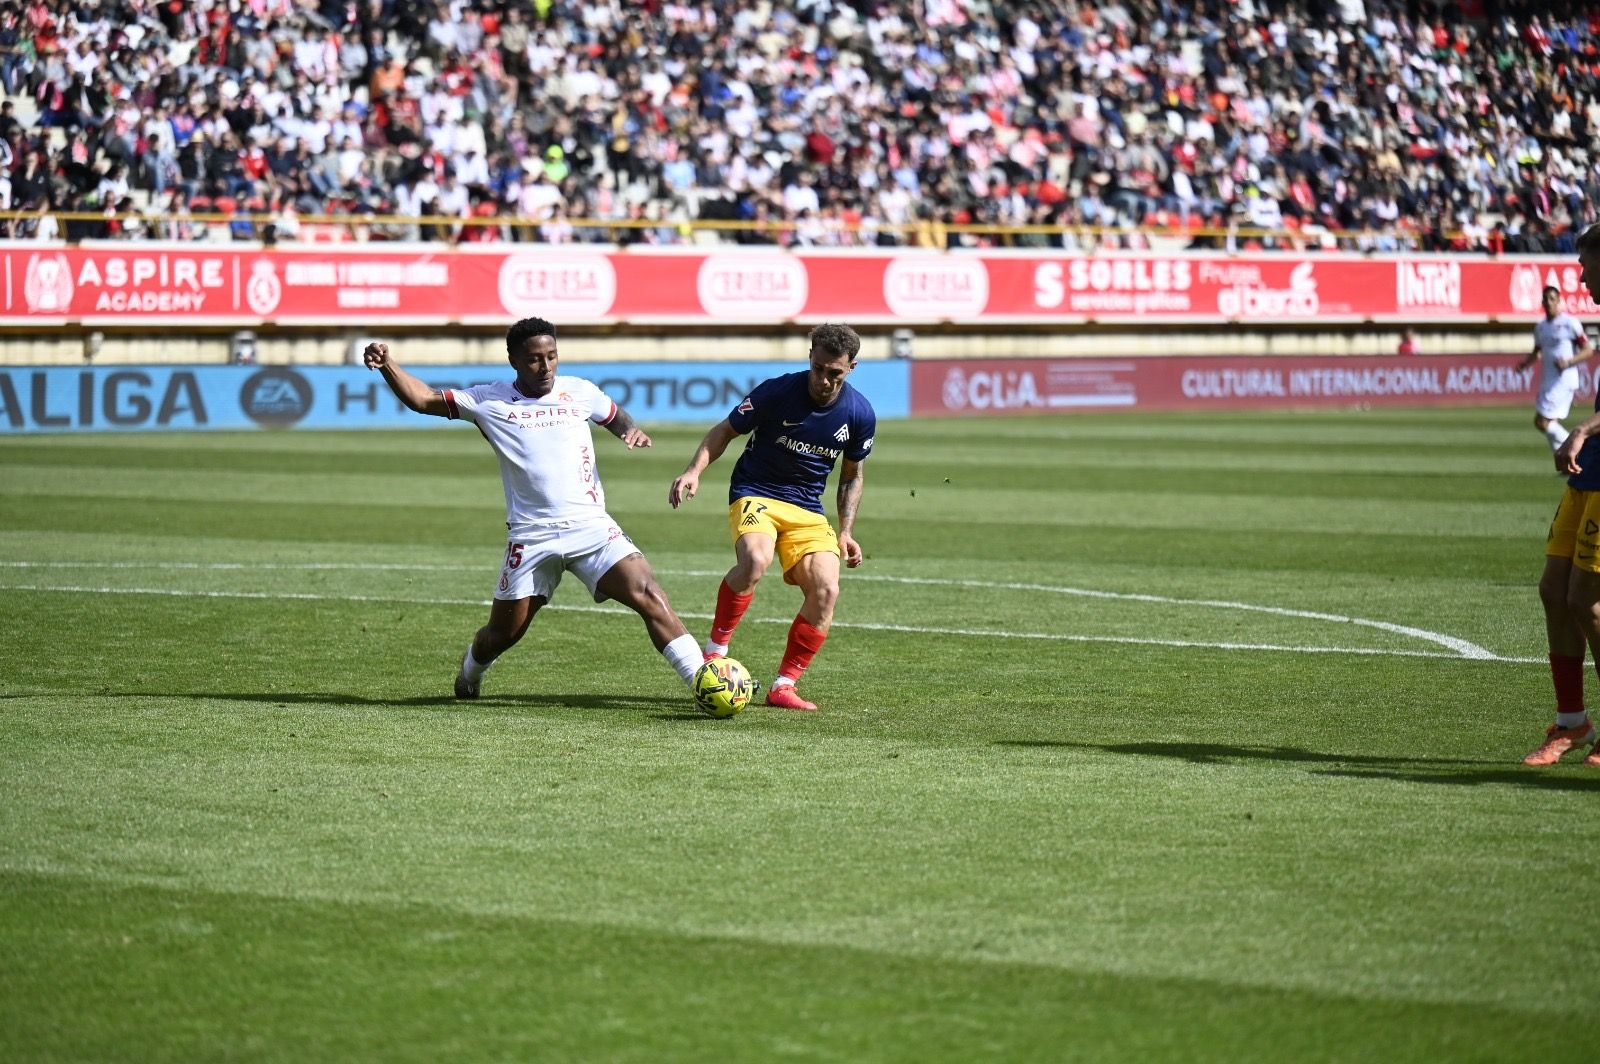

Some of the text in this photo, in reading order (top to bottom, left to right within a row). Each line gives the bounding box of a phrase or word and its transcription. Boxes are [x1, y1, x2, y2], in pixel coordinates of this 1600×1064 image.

[78, 254, 224, 292] ASPIRE
[1069, 260, 1191, 290] SORLES
[96, 292, 206, 312] ACADEMY
[1182, 365, 1535, 398] CULTURAL INTERNACIONAL ACADEMY
[507, 408, 580, 420] ASPIRE
[580, 446, 593, 483] MGS
[742, 500, 768, 514] 17
